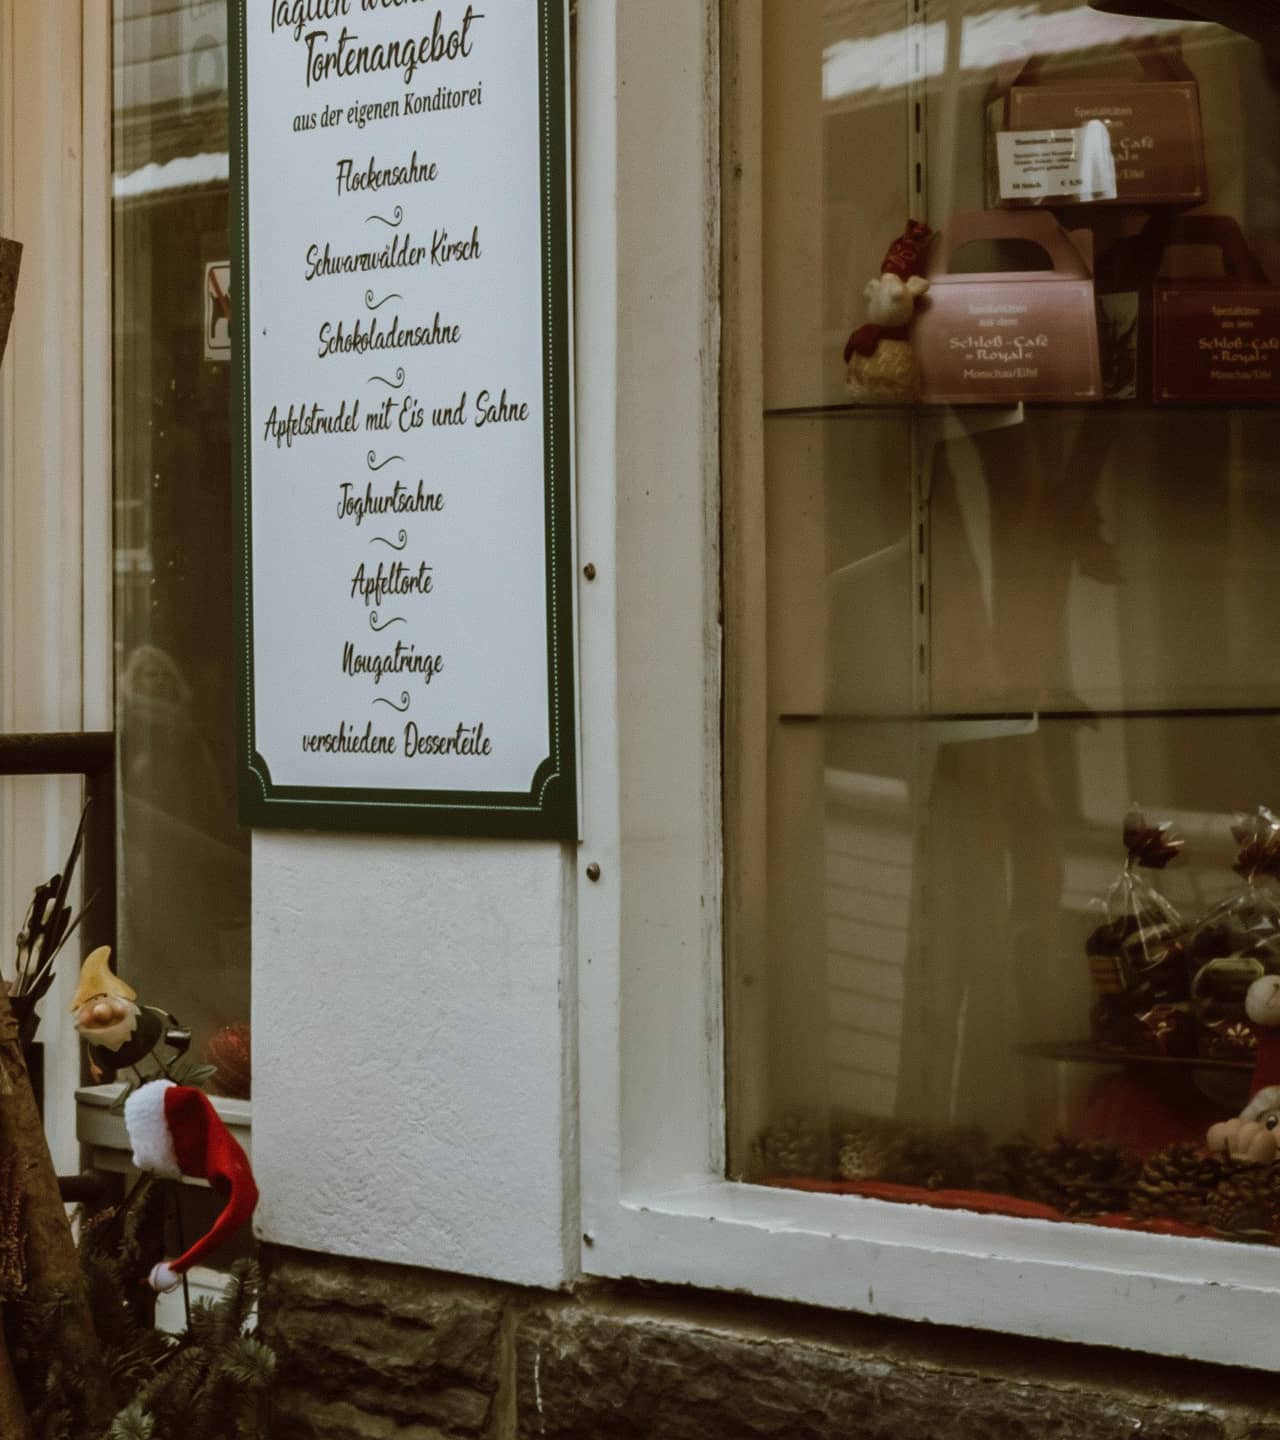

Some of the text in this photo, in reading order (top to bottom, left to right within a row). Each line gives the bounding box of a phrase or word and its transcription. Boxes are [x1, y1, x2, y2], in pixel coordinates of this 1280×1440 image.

[305, 6, 485, 89] Tortenangebot
[292, 81, 484, 133] aus der eigenen Konditorei
[336, 150, 439, 197] Flockensahne
[305, 225, 483, 281] Schwarzwälder Kirsch
[317, 312, 462, 359] Schokoladensahne
[264, 388, 530, 448] Apfelstrudel mit Eis und Sahne
[337, 479, 444, 527] Joghurtsahne
[350, 561, 434, 606] Apfeltorte
[342, 640, 443, 684] Nougatringe
[302, 721, 396, 755] verschiedene
